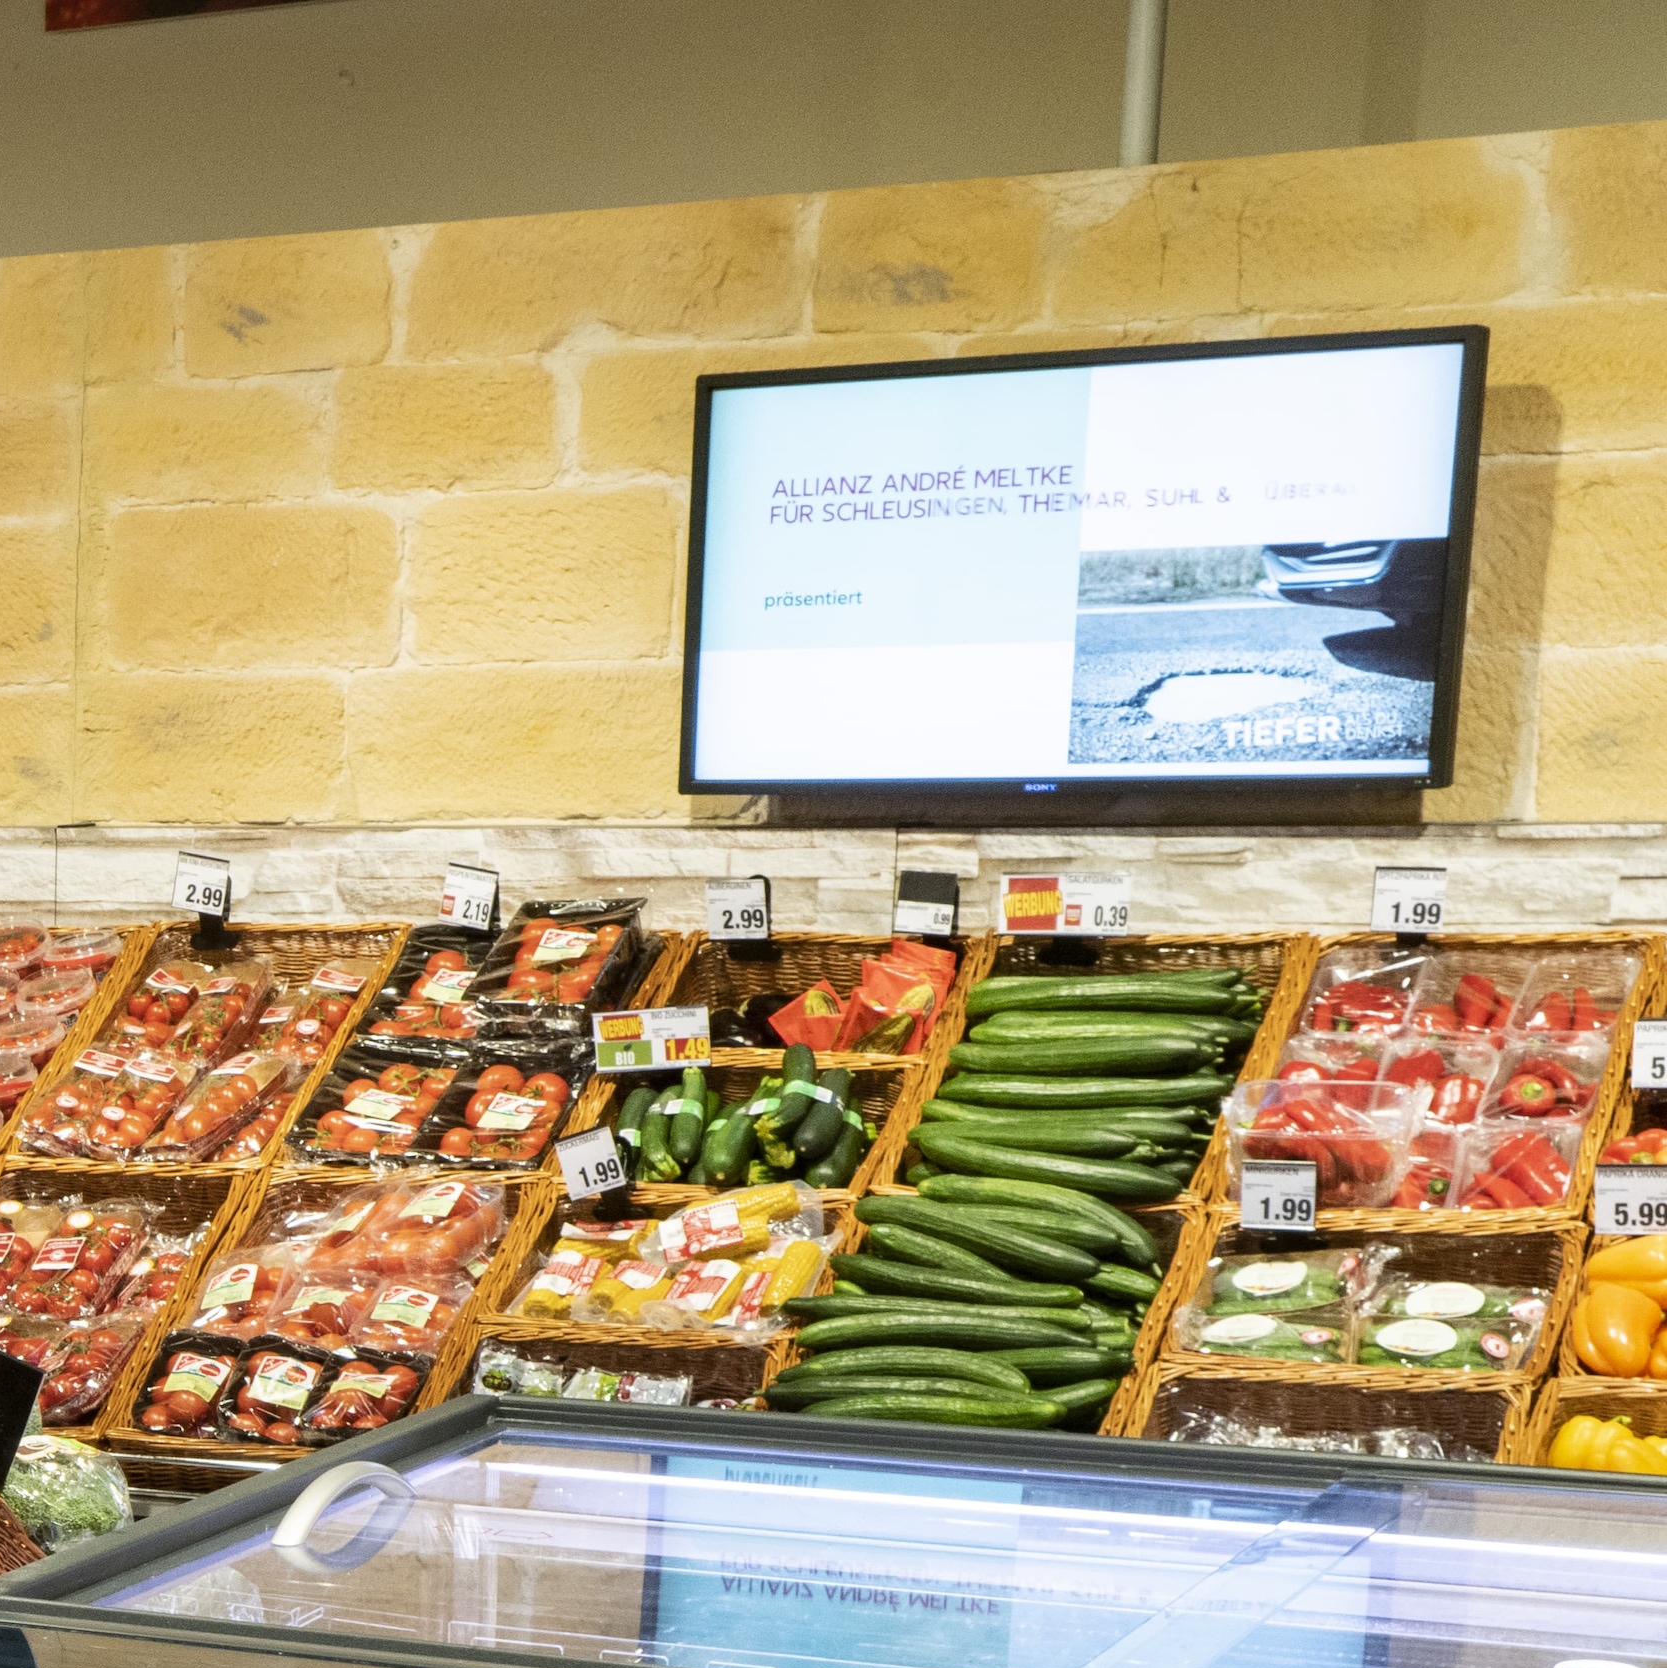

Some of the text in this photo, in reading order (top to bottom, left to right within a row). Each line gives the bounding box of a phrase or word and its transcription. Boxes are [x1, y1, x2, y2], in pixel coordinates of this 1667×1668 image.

[772, 464, 1073, 499] ALLIANZ ANDRÉ MELTKE
[769, 500, 814, 524] FÜR
[1145, 488, 1205, 509] SUHL
[763, 588, 864, 612] präsentiert
[1223, 714, 1342, 748] TIEFER
[1023, 782, 1058, 792] SONY
[185, 884, 224, 909] 2.99
[1003, 889, 1064, 918] WERBUNG
[463, 898, 490, 922] 2.19
[722, 909, 765, 930] 2.99
[933, 912, 952, 925] 0.99
[1094, 905, 1128, 927] 0.39
[1391, 903, 1442, 925] 1.99
[598, 1013, 644, 1040] WERBUNG
[614, 1051, 636, 1066] BIO
[666, 1038, 710, 1061] 1.49
[1650, 1056, 1666, 1078] 5
[578, 1157, 623, 1189] 1.99
[1259, 1197, 1314, 1222] 1.99
[1613, 1201, 1667, 1227] 5.99
